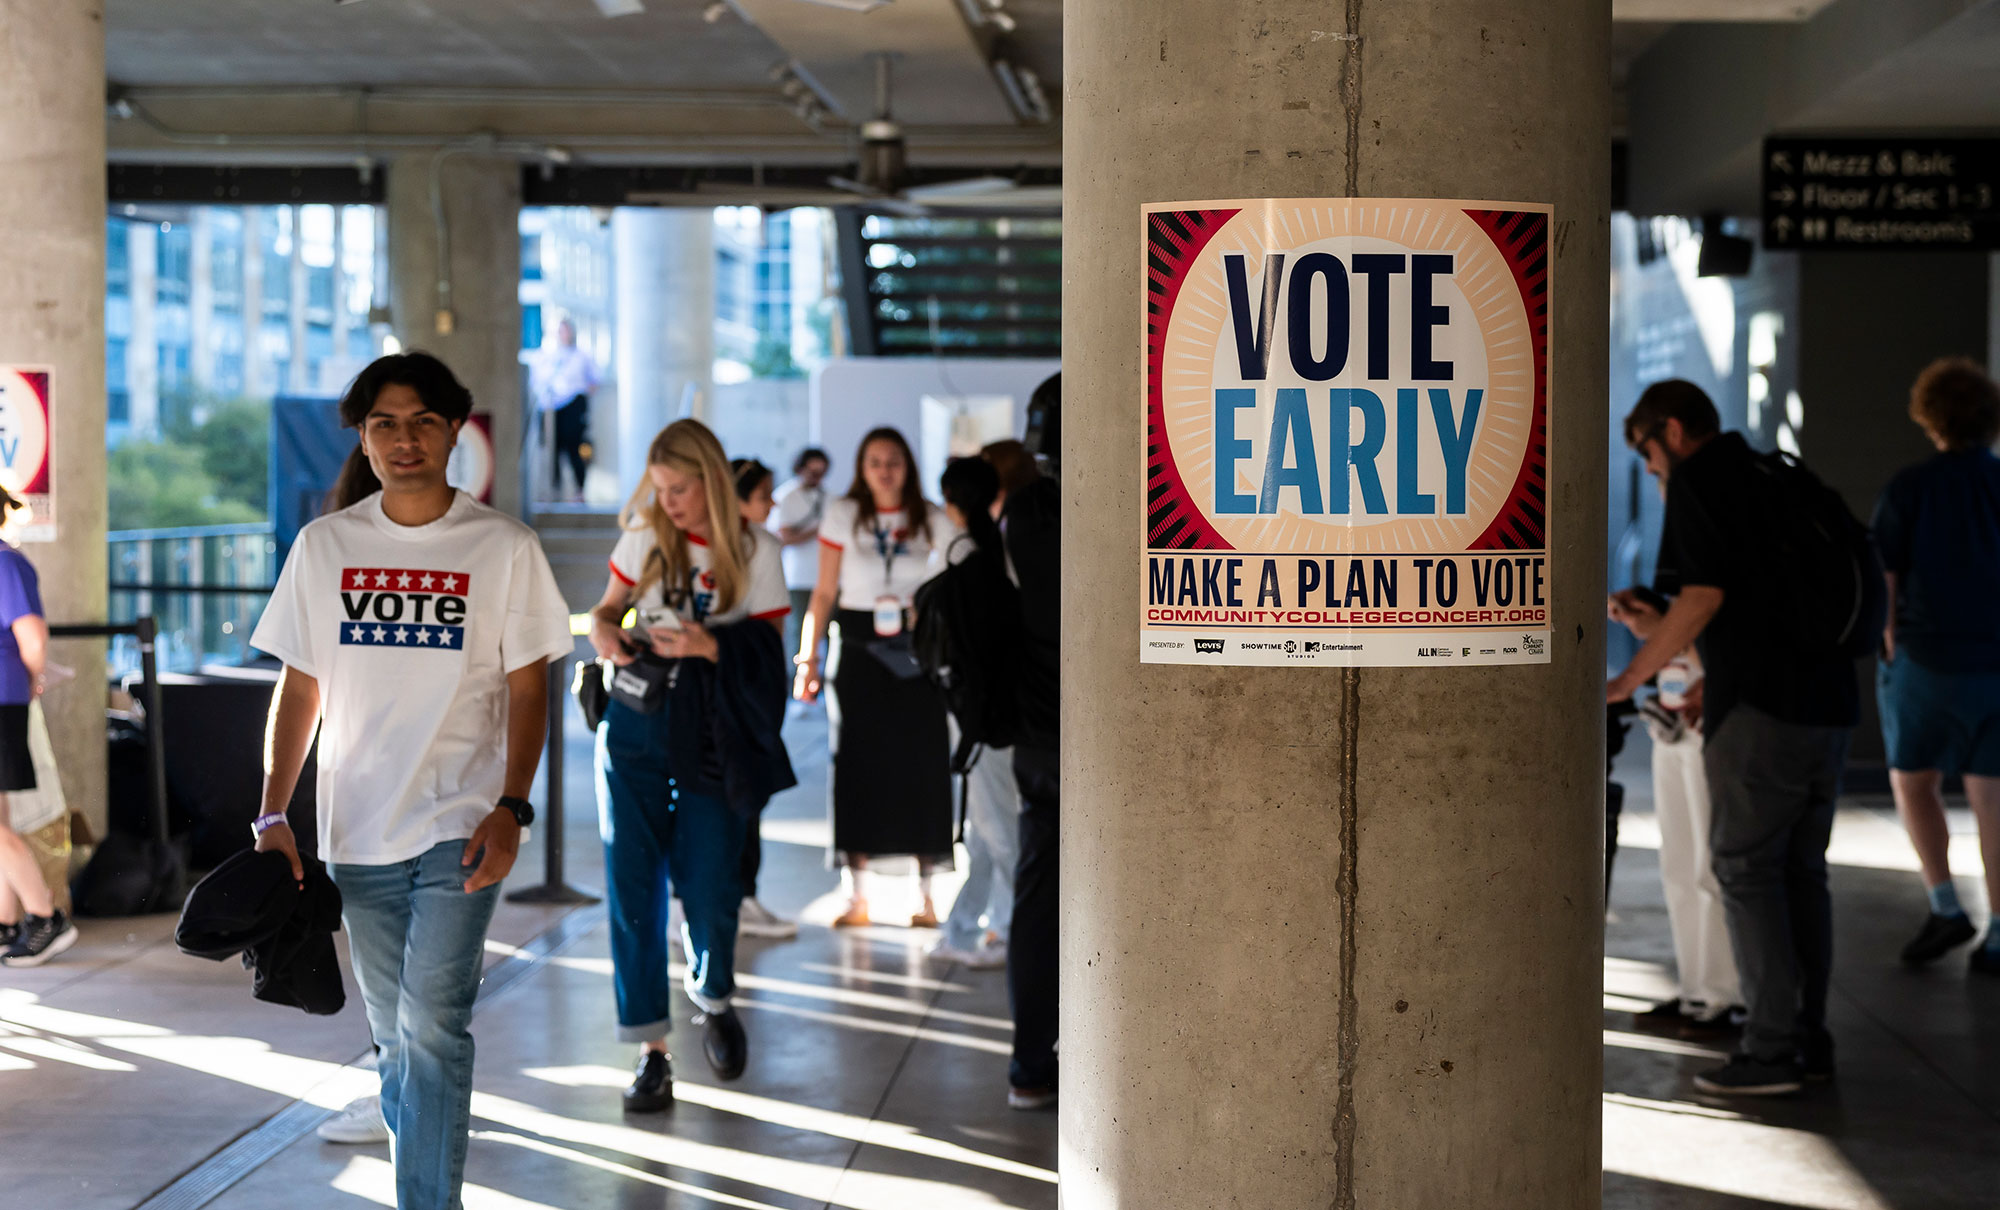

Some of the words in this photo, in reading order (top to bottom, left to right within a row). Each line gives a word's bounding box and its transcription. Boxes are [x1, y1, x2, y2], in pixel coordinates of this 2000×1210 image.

[1803, 151, 1872, 176] Mezz
[1876, 151, 1897, 177] &
[1901, 151, 1955, 176] Balc
[1802, 183, 1870, 209] Floor
[1874, 183, 1890, 209] /
[1892, 183, 1938, 209] Sec
[1834, 217, 1973, 242] Restrooms
[1224, 252, 1454, 381] VOTE
[1215, 388, 1484, 515] EARLY
[1148, 557, 1243, 607] MAKE
[1256, 559, 1282, 608] A
[1298, 559, 1398, 608] PLAN
[1413, 558, 1459, 608] TO
[1471, 557, 1545, 607] VOTE
[1147, 608, 1545, 624] COMMUNITYCOLLEGECONCERT.ORG
[1322, 643, 1363, 651] Entertainment
[1417, 647, 1430, 656] ALL
[1430, 647, 1437, 656] IN
